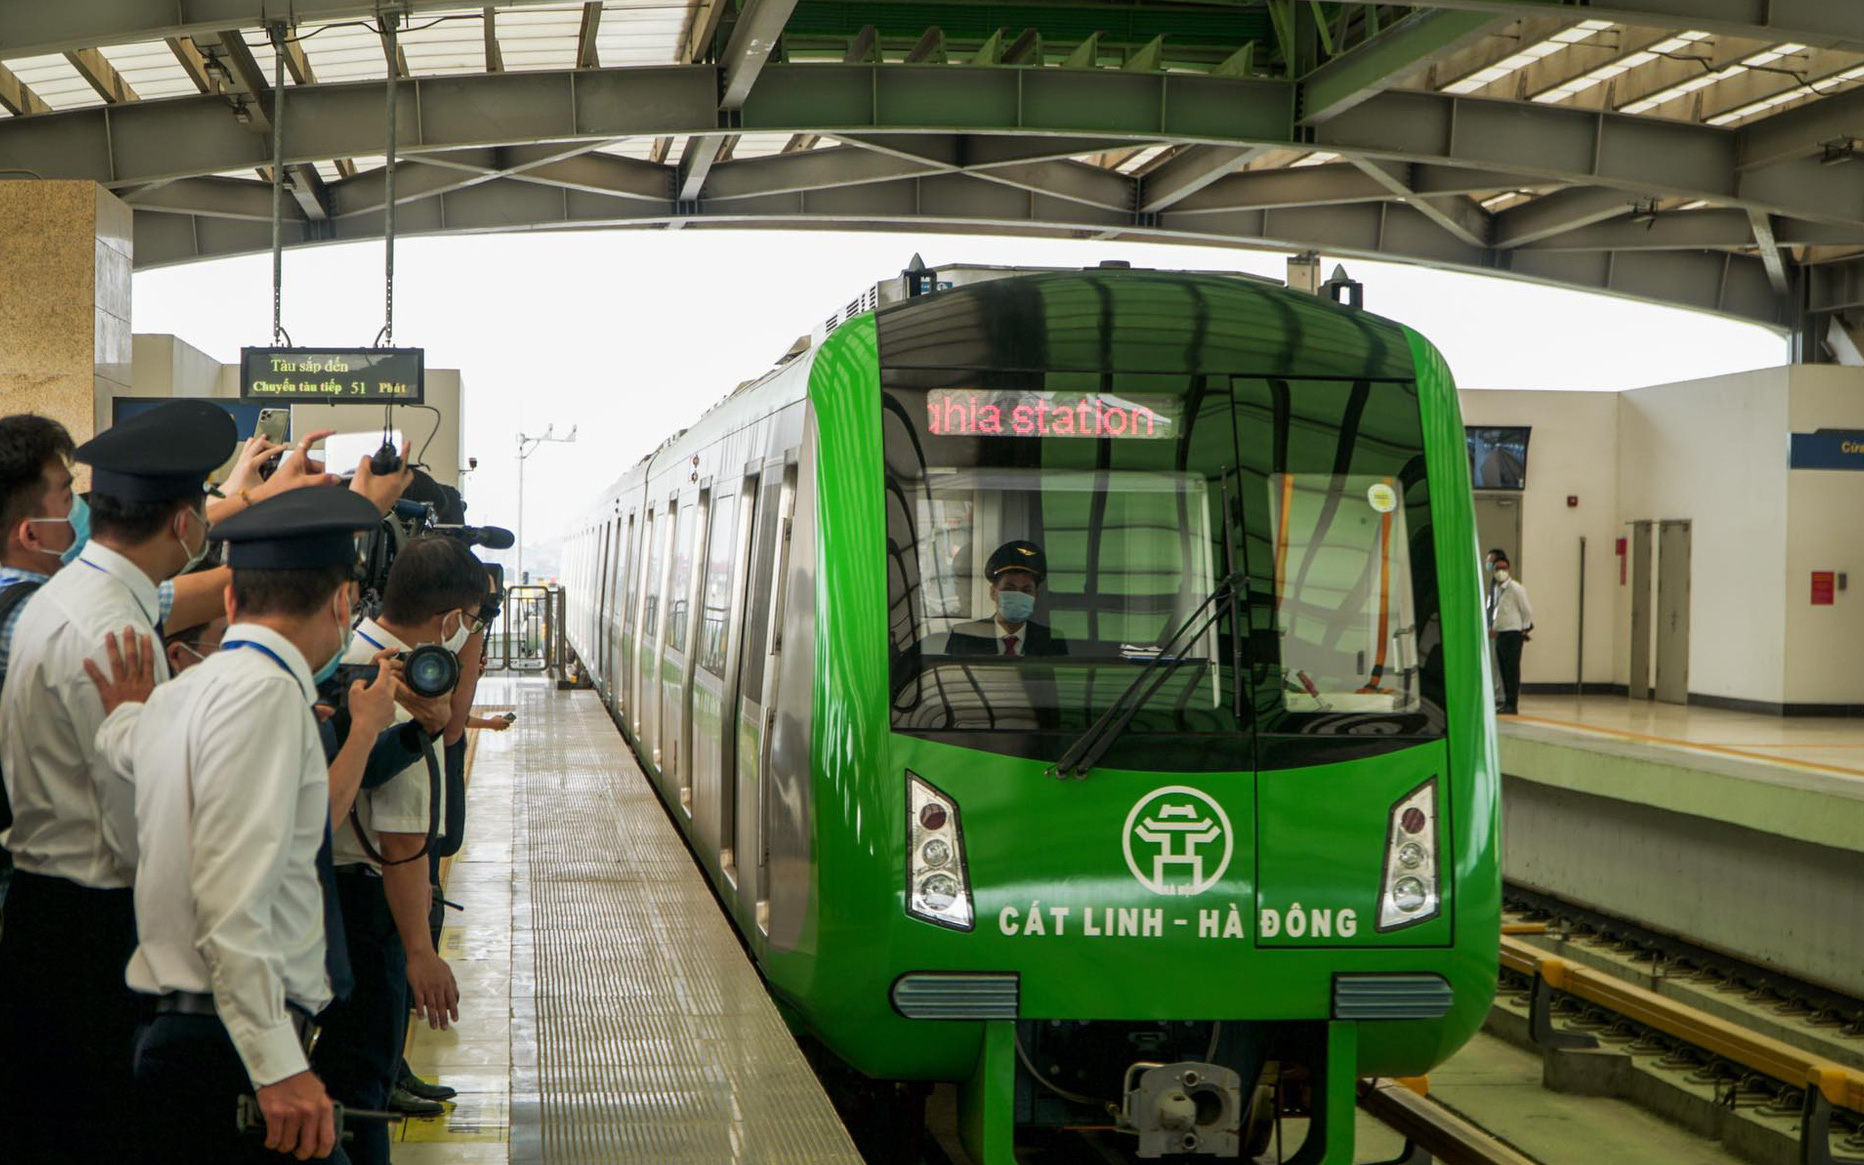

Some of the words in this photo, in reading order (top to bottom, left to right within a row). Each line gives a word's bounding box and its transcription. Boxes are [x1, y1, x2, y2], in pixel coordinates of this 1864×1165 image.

[270, 358, 296, 373] Tàu
[324, 356, 349, 373] đến
[252, 378, 296, 395] Chuyến
[298, 381, 317, 393] tàu
[320, 378, 343, 395] tiếp
[351, 382, 366, 394] 51
[1011, 398, 1155, 436] station
[999, 900, 1070, 936] CÁT
[1083, 907, 1164, 937] LINH
[1198, 903, 1245, 939] HÀ
[1260, 902, 1358, 938] ĐÔNG
